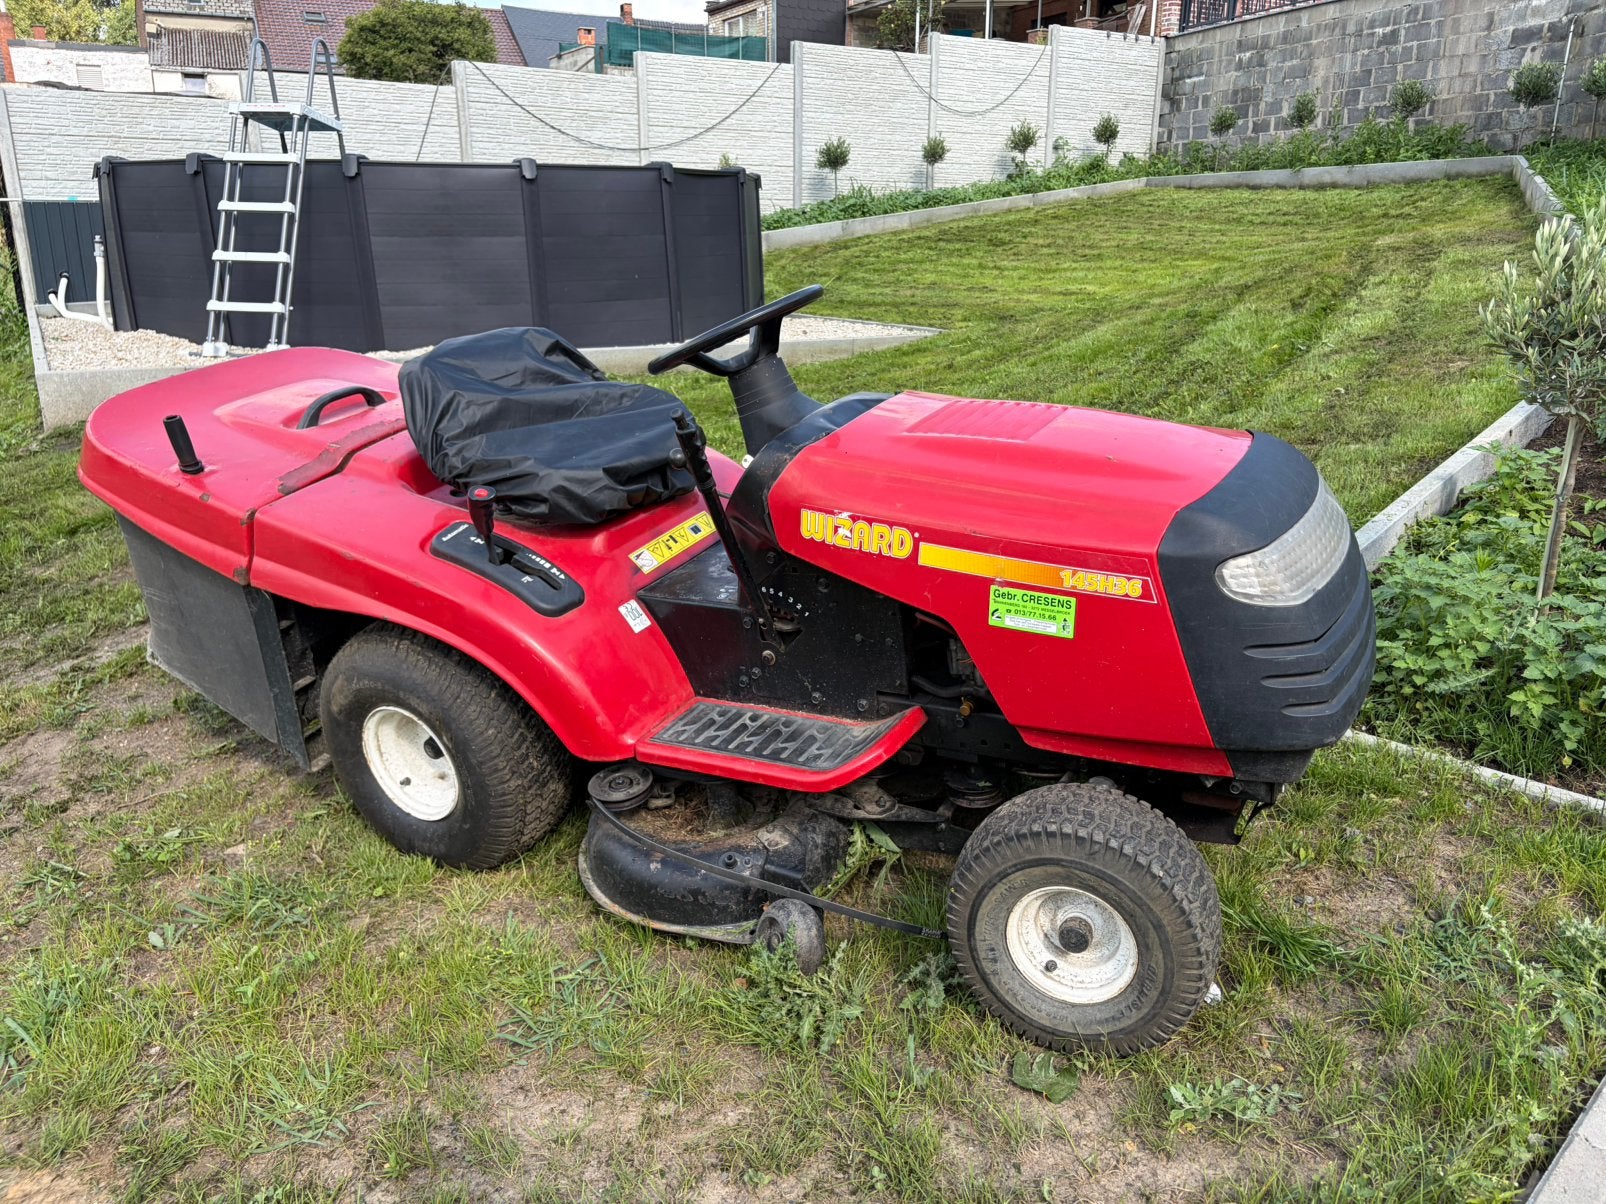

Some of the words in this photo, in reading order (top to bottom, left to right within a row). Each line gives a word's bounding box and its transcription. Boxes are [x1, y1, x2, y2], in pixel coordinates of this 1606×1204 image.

[800, 509, 914, 559] WIZARD
[769, 587, 775, 595] 5
[1060, 570, 1143, 598] 145H36
[993, 589, 1020, 602] Gebr.
[1021, 593, 1072, 610] CRESENS
